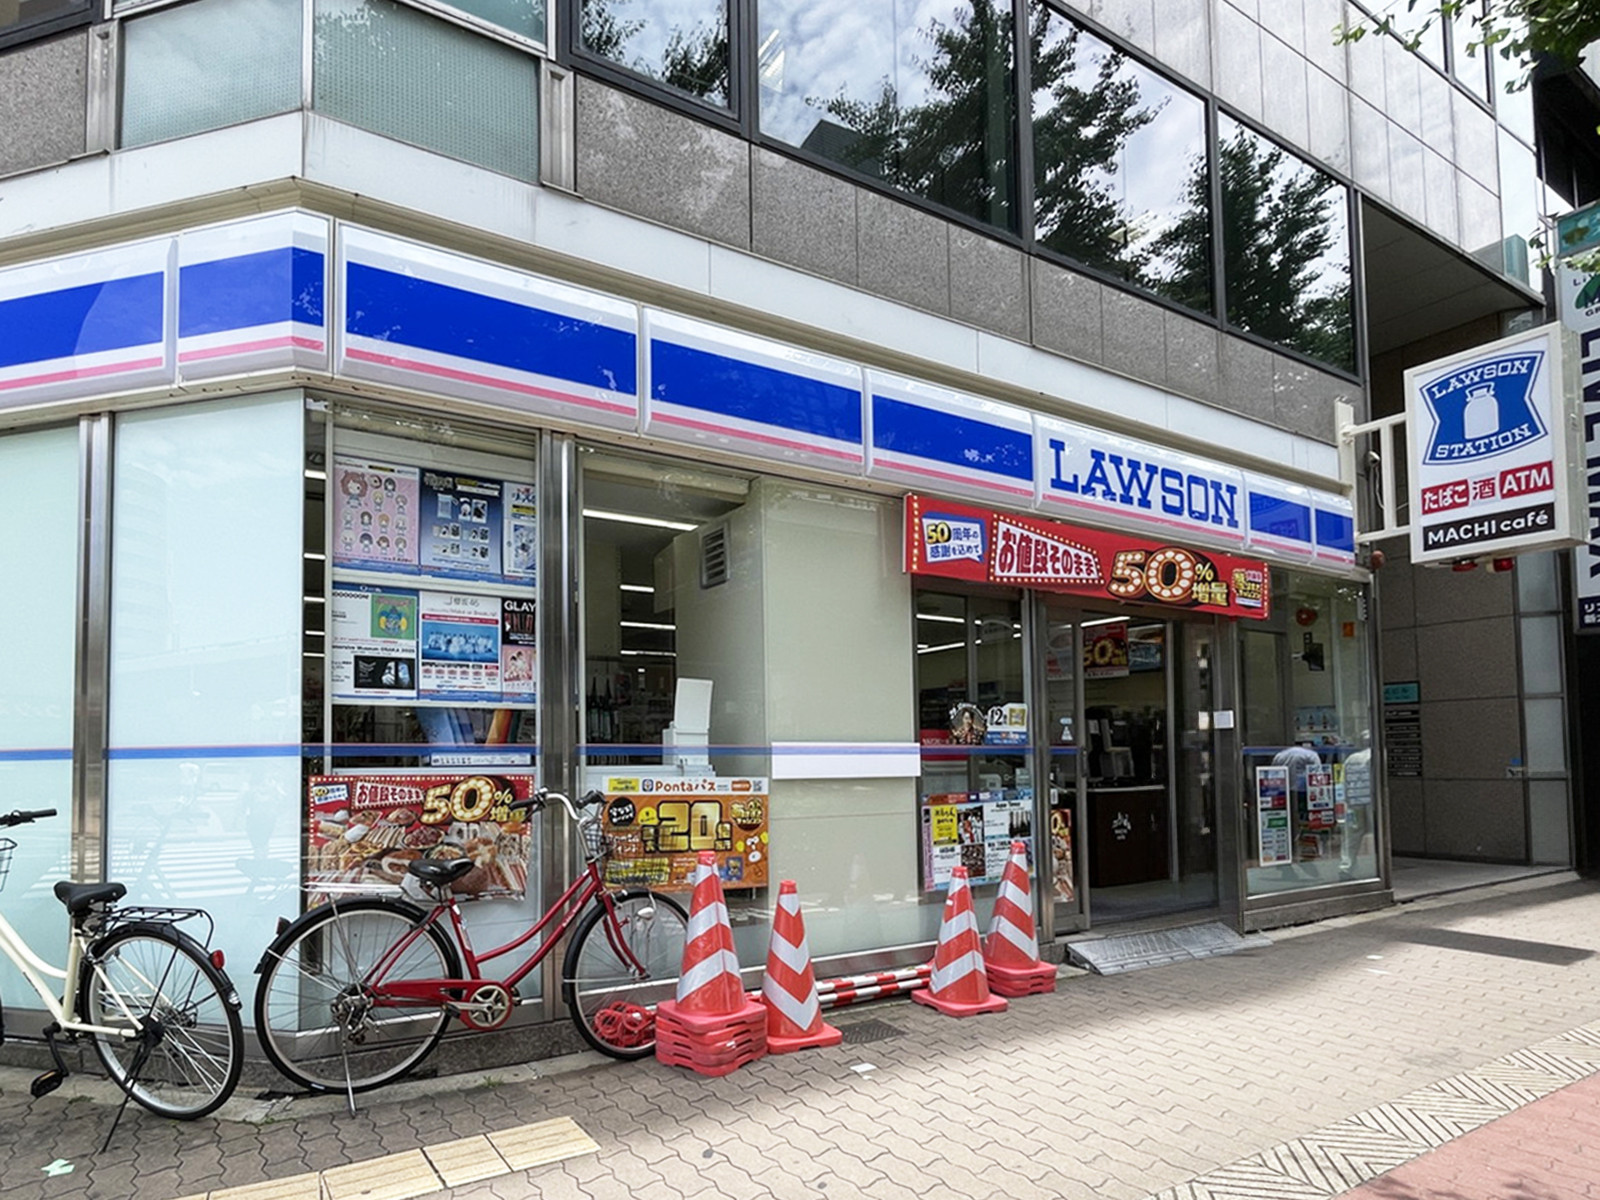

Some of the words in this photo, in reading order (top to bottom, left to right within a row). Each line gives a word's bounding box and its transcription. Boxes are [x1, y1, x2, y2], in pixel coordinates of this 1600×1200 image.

[1431, 358, 1531, 400] LAWSON
[1435, 423, 1532, 459] STATION
[1049, 438, 1239, 529] LAWSON
[1423, 483, 1468, 511] たばこ
[1472, 476, 1497, 501] 酒
[1502, 466, 1551, 495] ATM
[926, 521, 979, 545] 50周年の
[1427, 519, 1497, 545] MACHI
[1500, 509, 1549, 532] café
[999, 527, 1095, 577] お値段そのまま
[504, 600, 536, 613] GLAY
[655, 778, 716, 793] Pontaパス
[658, 802, 722, 851] 20
